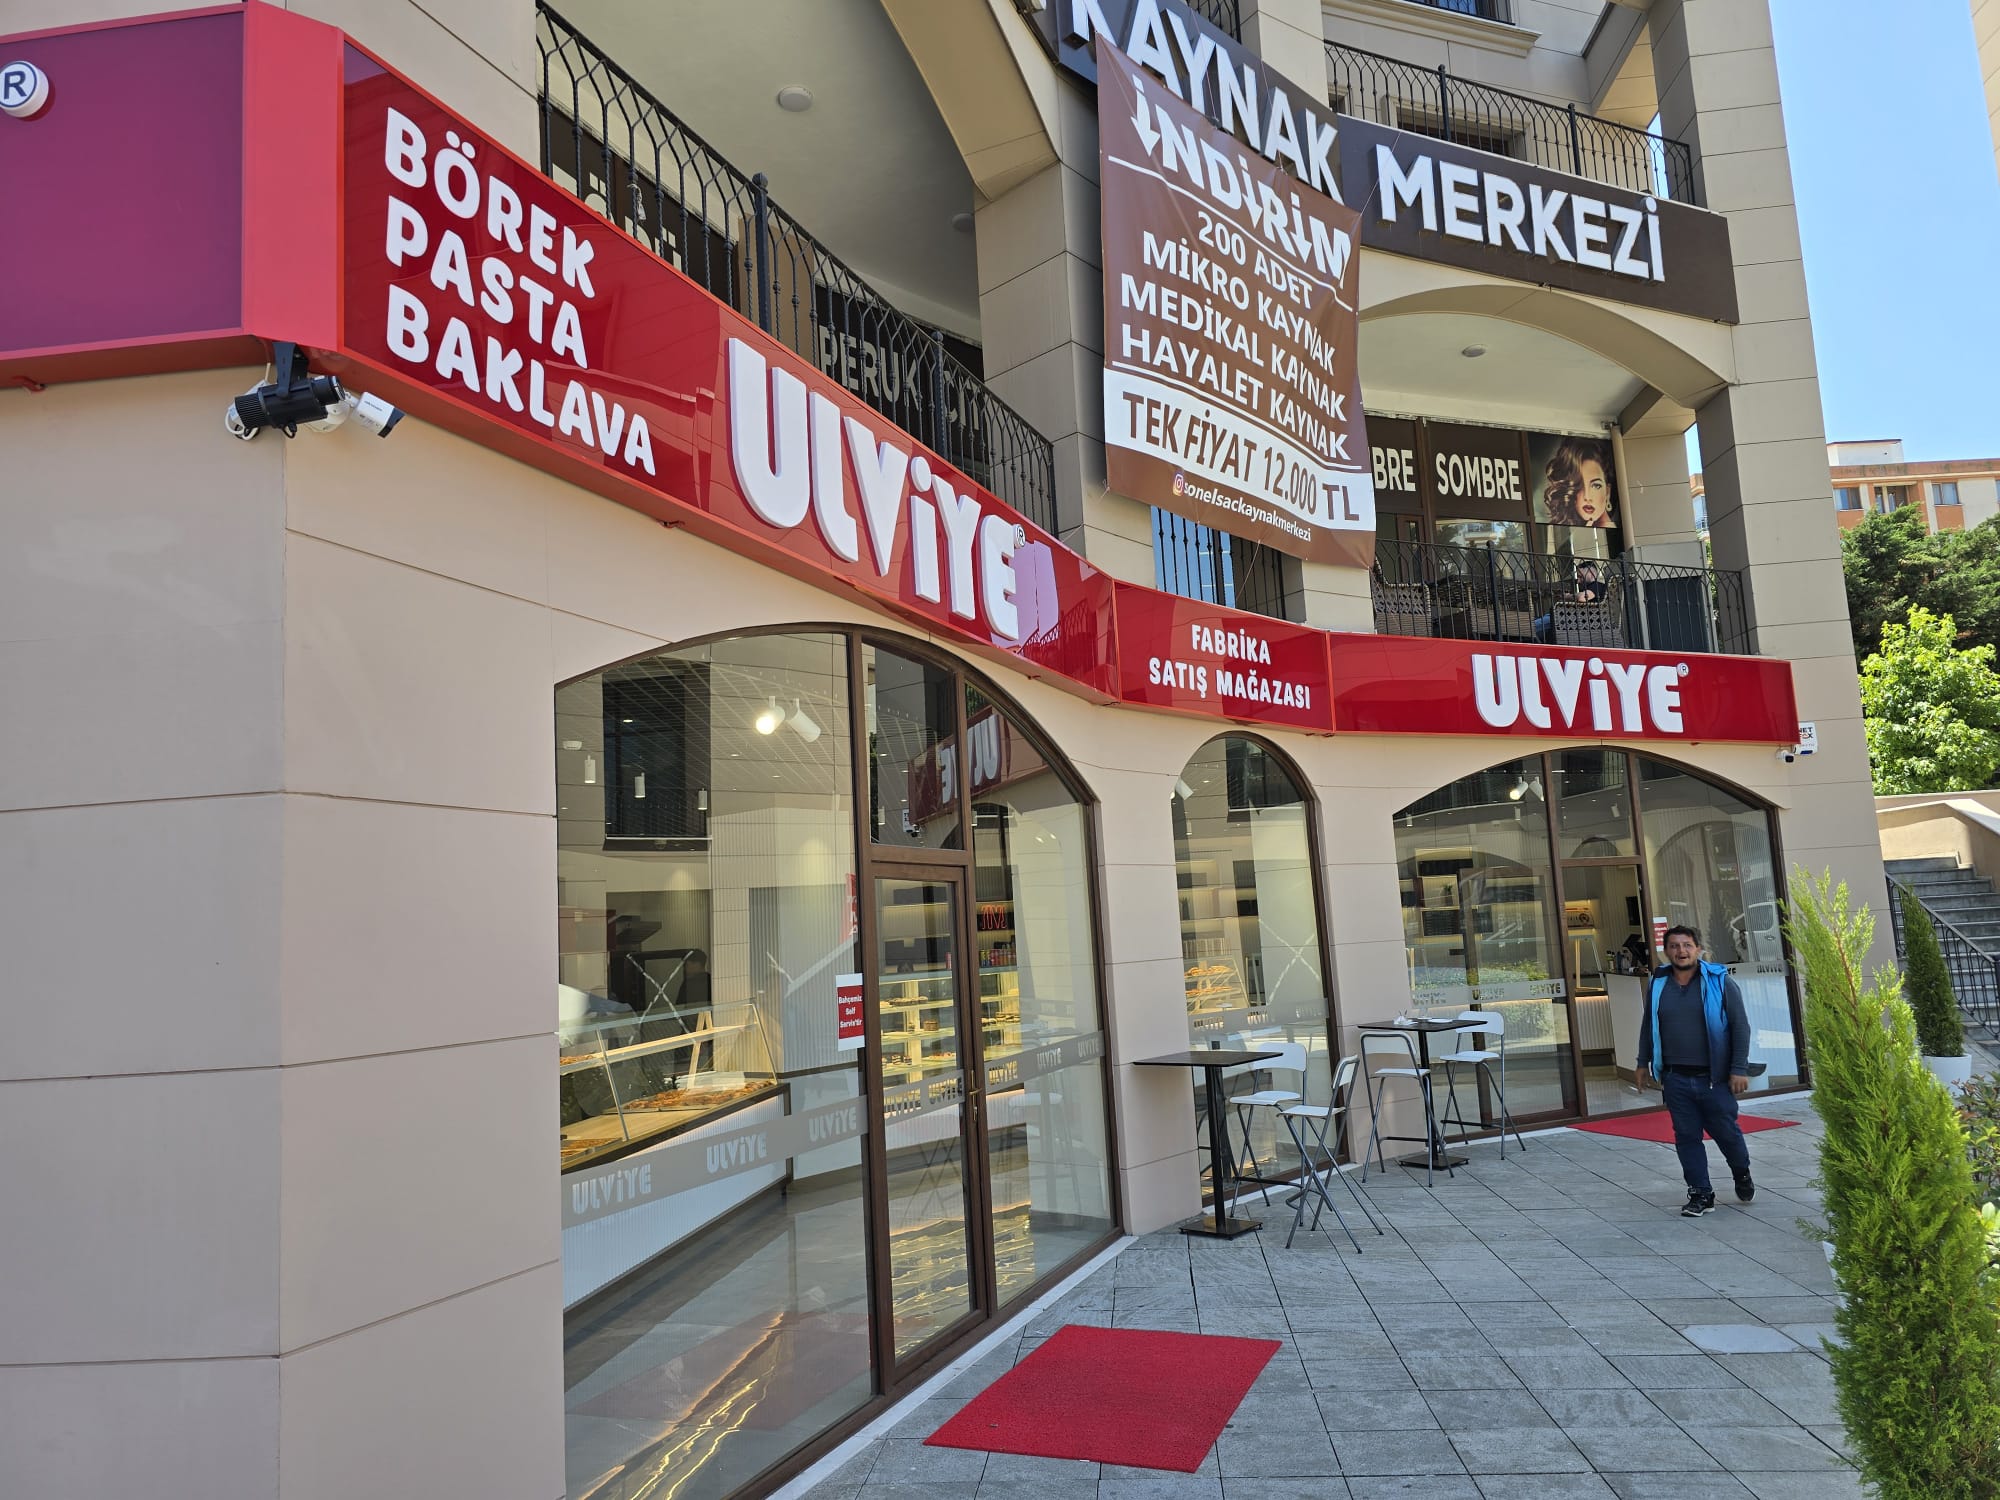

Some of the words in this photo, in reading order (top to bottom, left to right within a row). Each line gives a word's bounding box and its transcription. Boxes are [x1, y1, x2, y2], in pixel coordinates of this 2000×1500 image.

[385, 107, 595, 298] BÖREK
[1198, 212, 1246, 265] 200
[1253, 250, 1313, 309] ADET
[1374, 143, 1665, 283] MERKEZİ
[386, 196, 588, 369] PASTA
[1121, 273, 1264, 366] MEDİKAL
[1271, 344, 1347, 421] KAYNAK
[1143, 231, 1250, 310] MİKRO
[1258, 291, 1335, 376] KAYNAK
[386, 284, 656, 475] BAKLAVA
[1122, 323, 1264, 410] HAYALET
[1270, 389, 1352, 460] KAYNAK
[1122, 391, 1182, 453] TEK
[1183, 408, 1257, 482] FİYAT
[1264, 446, 1317, 515] 12.000
[1322, 483, 1360, 521] TL
[1184, 481, 1311, 542] sonelsackaynakmerkezi
[1368, 446, 1416, 491] BRE
[1435, 452, 1522, 500] SOMBRE
[1149, 657, 1208, 698] SATIŞ
[1216, 669, 1311, 709] MAĞAZASI
[1191, 624, 1271, 665] FABRİKA
